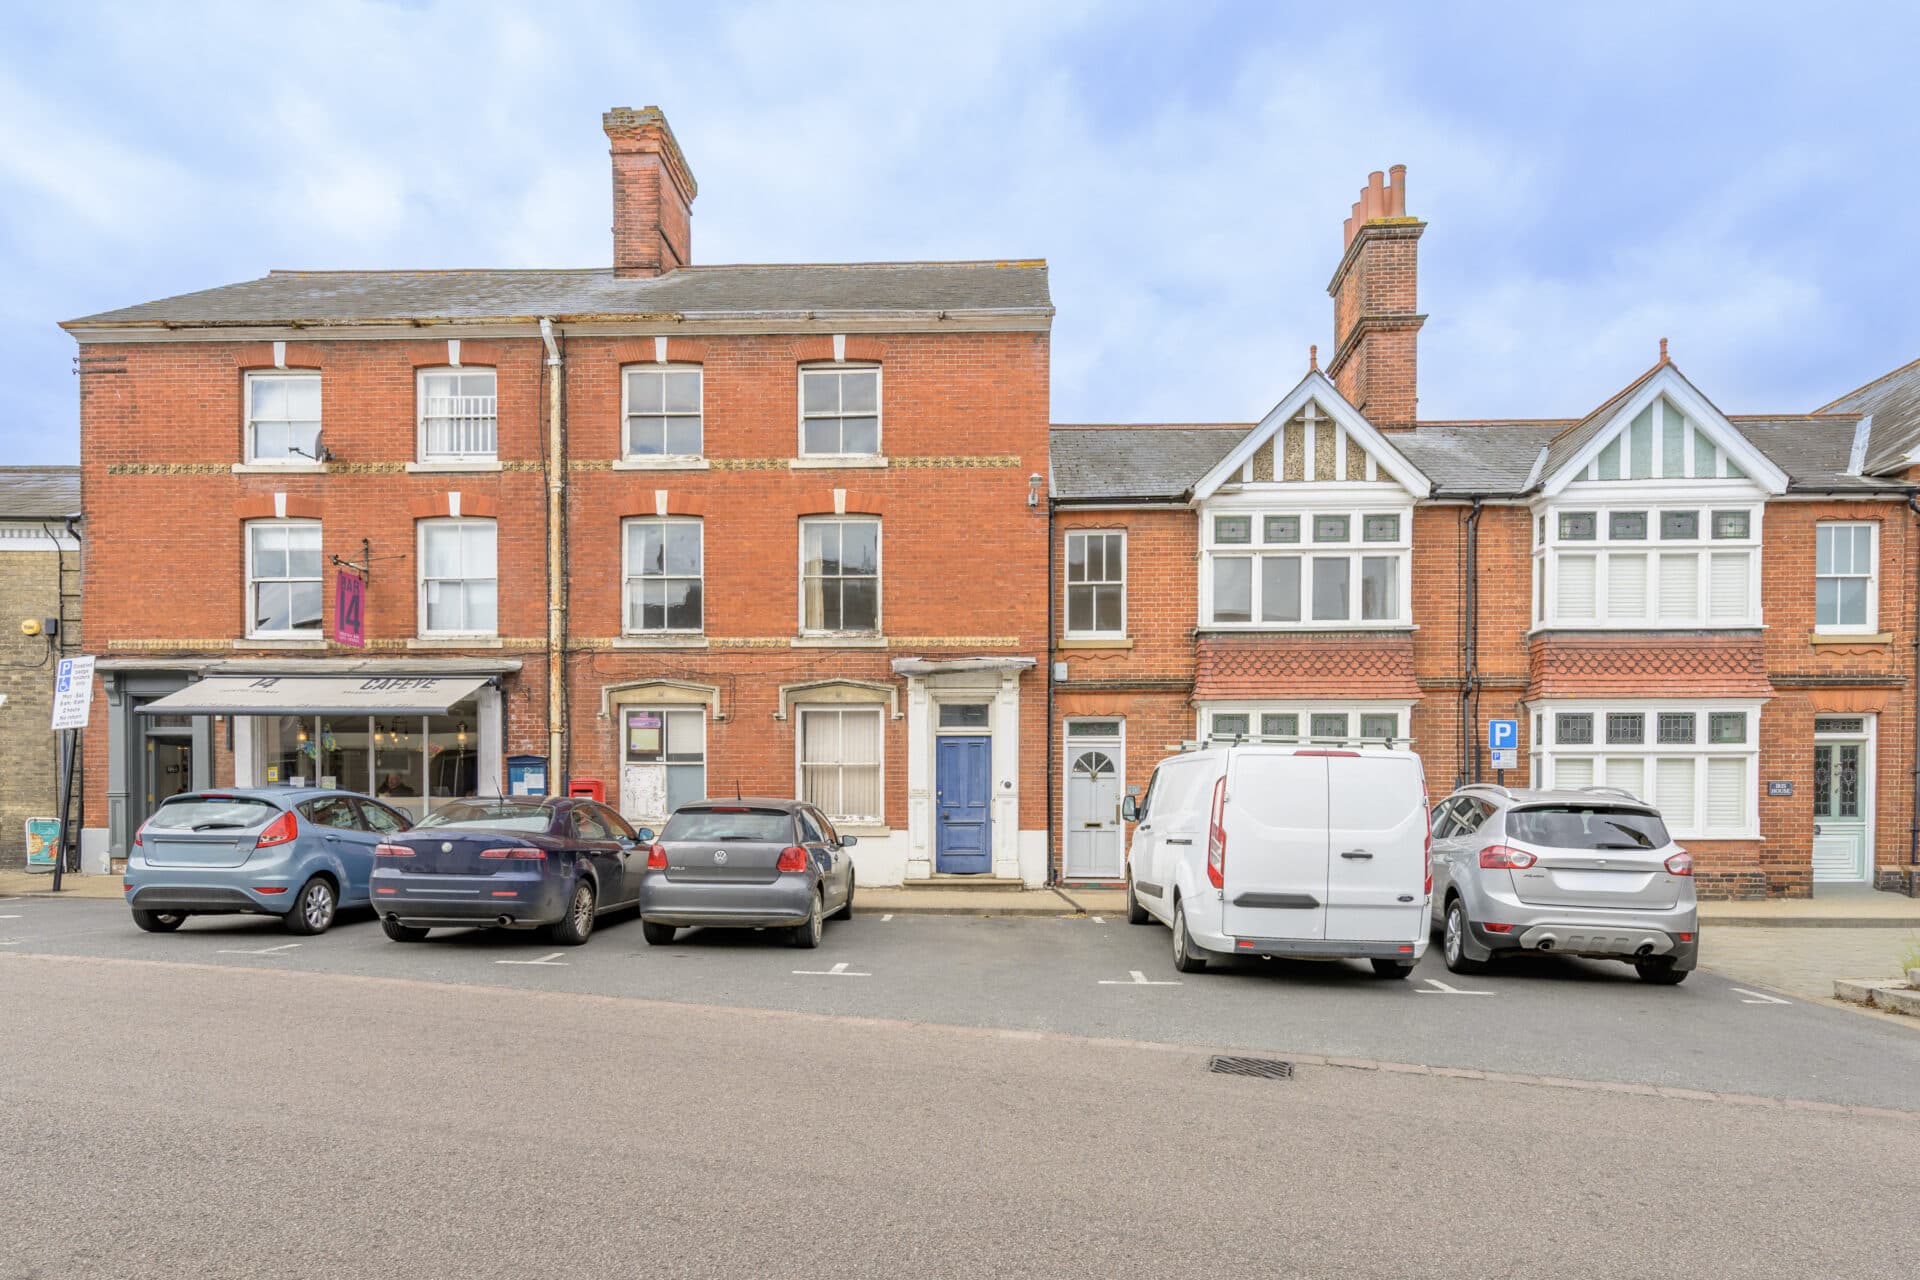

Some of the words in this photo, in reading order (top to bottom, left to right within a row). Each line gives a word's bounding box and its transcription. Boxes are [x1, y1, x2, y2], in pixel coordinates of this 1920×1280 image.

[341, 575, 360, 593] BAR
[340, 590, 360, 634] 14
[62, 662, 71, 675] P
[1495, 723, 1511, 746] P
